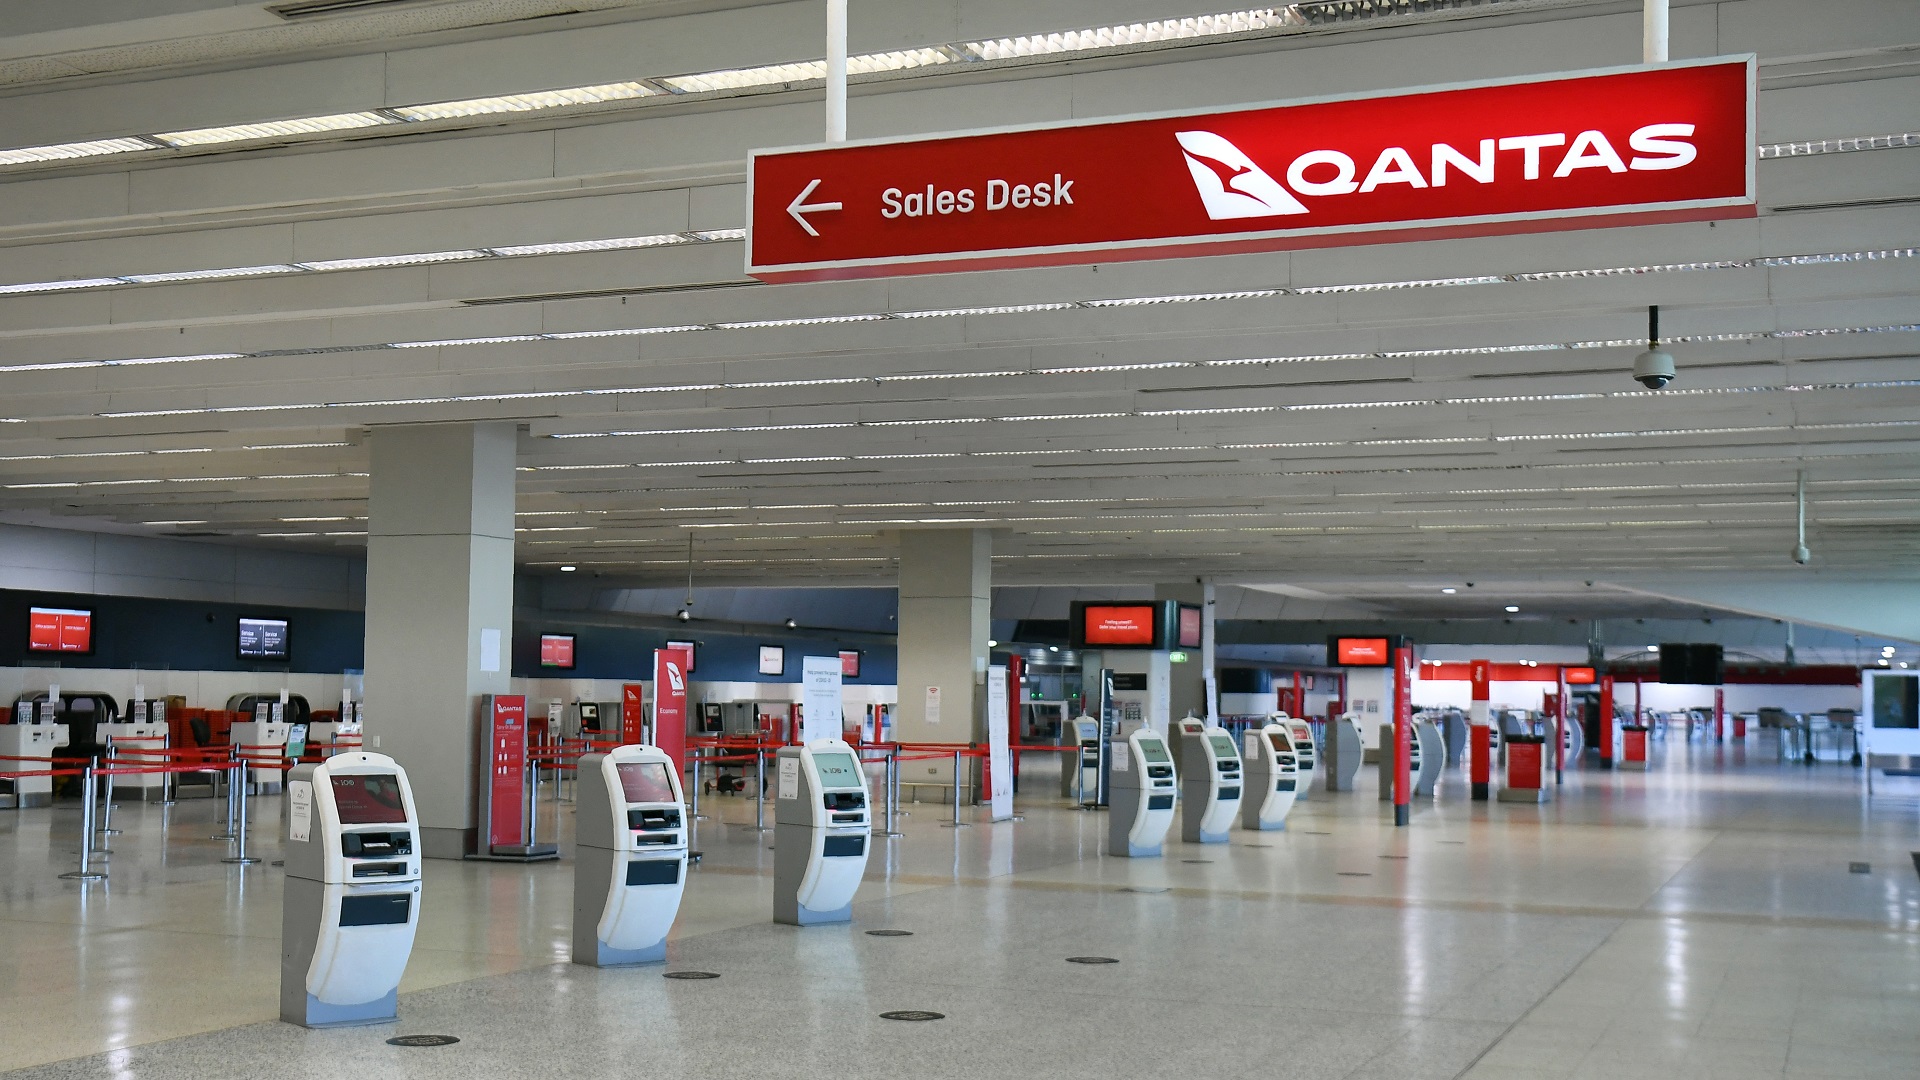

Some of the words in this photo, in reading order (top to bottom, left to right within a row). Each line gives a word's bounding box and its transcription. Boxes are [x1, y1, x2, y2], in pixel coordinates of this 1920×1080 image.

[1286, 123, 1697, 198] QANTAS
[881, 183, 975, 219] Sales
[986, 173, 1074, 211] Desk
